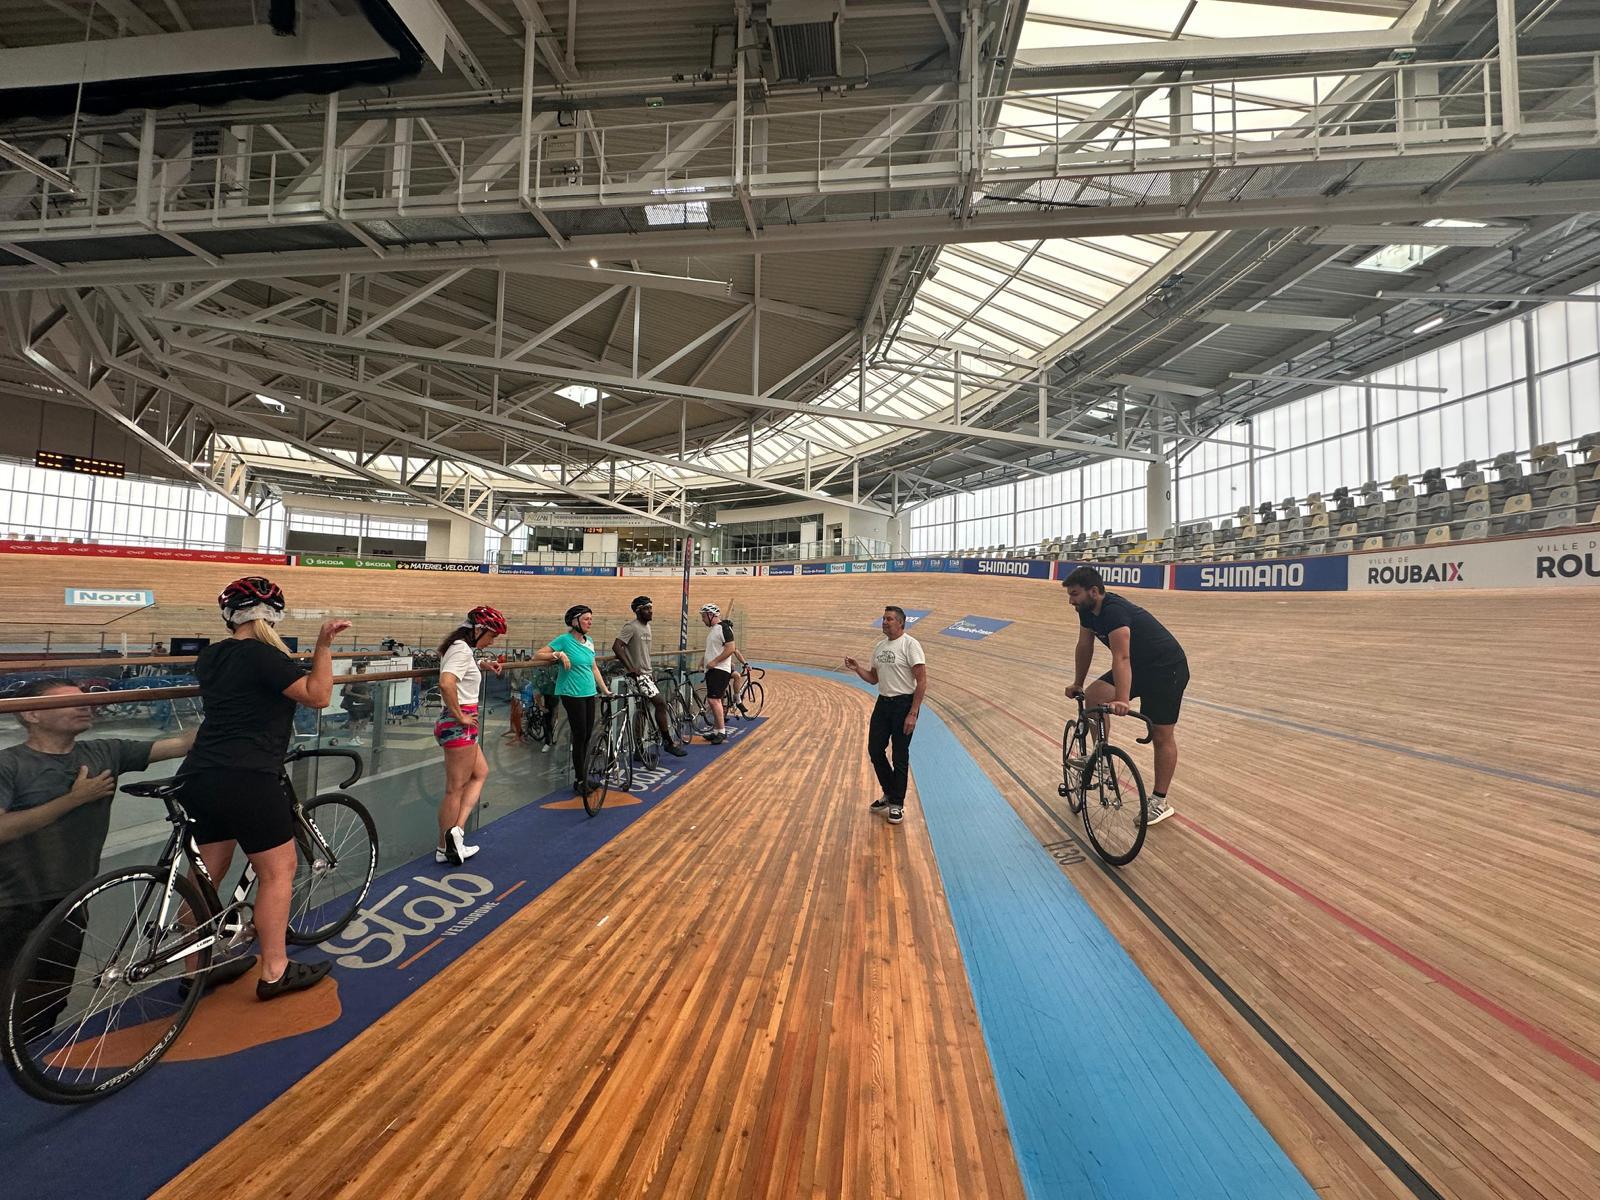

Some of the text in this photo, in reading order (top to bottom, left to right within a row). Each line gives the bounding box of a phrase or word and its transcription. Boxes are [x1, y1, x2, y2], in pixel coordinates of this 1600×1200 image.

[1537, 542, 1579, 552] VILLE
[978, 560, 1030, 575] SHIMANO
[1077, 565, 1141, 584] MANO
[1200, 562, 1305, 588] SHIMANO
[1367, 561, 1464, 585] ROUBAIX
[79, 592, 141, 602] Nord
[308, 818, 330, 849] LOOK
[317, 873, 494, 969] Stab
[441, 901, 500, 937] VELODROME
